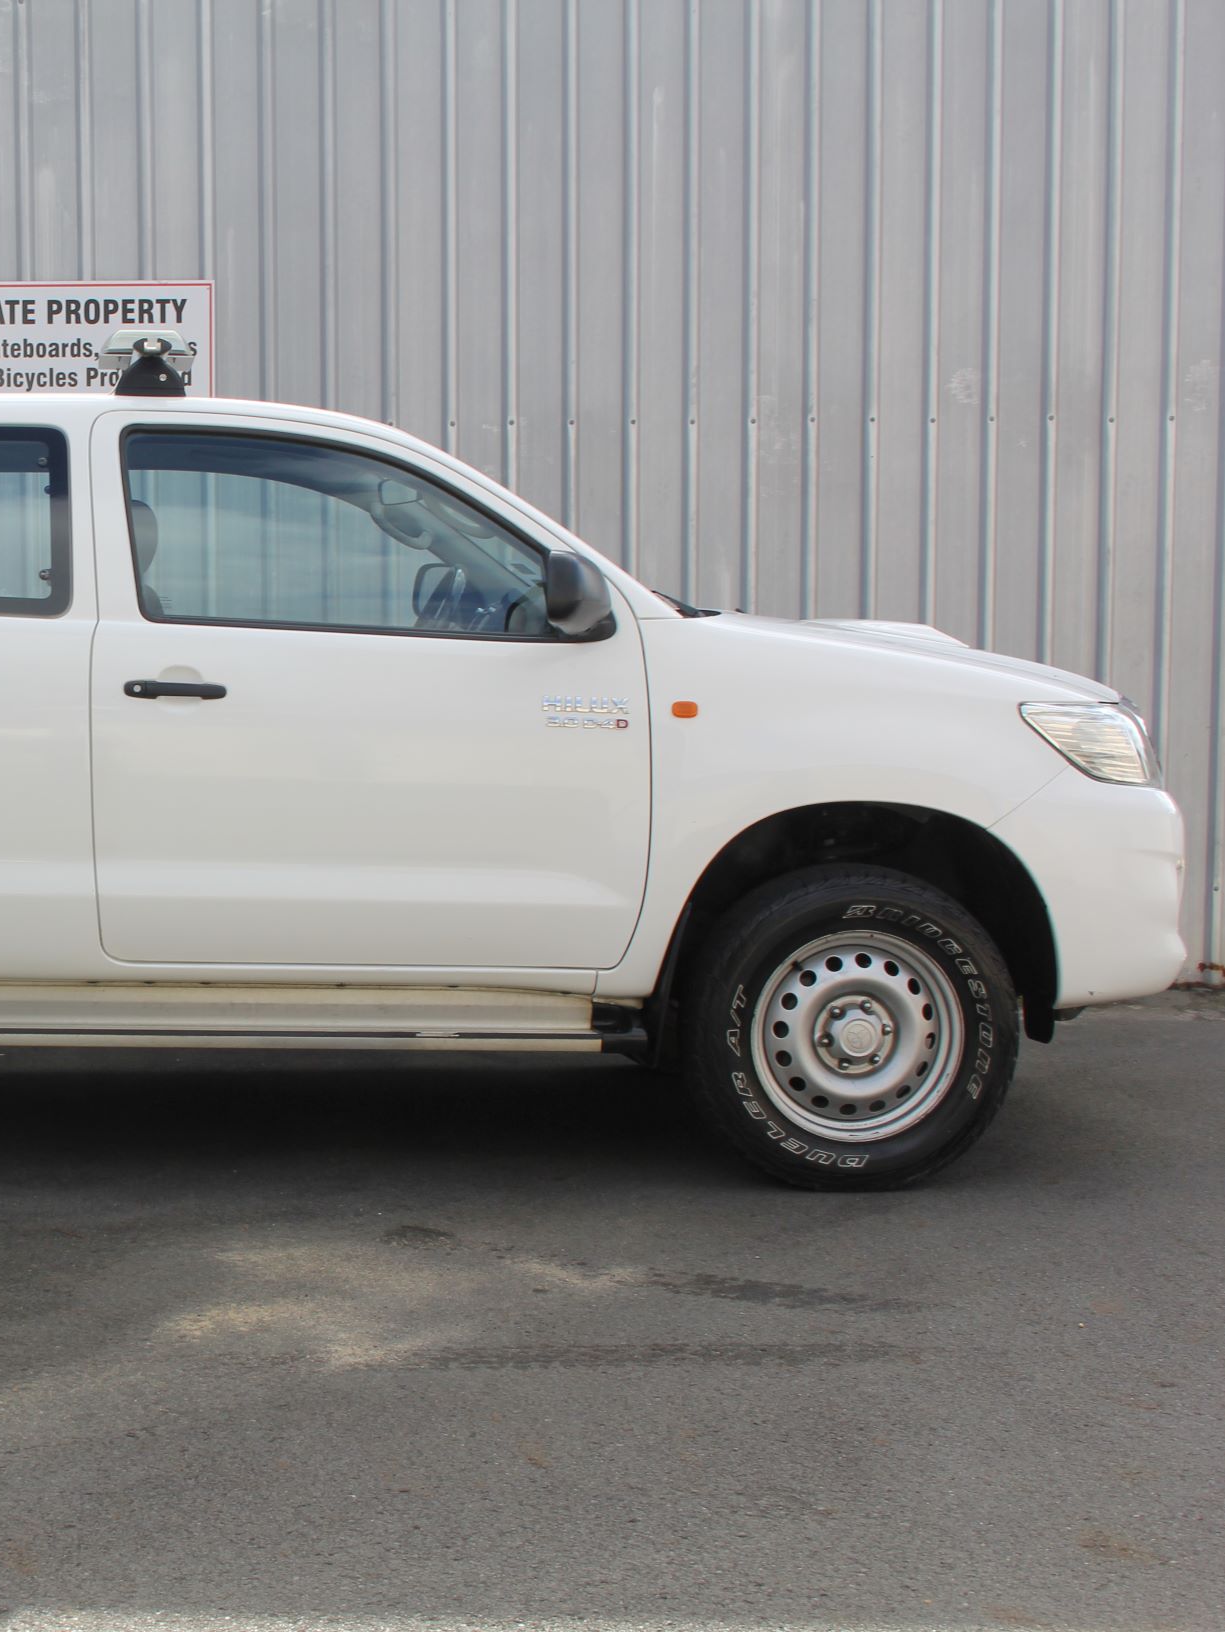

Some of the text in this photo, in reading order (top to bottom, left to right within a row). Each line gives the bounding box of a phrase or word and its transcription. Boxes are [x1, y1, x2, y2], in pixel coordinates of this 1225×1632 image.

[47, 299, 188, 324] PROPERTY
[542, 696, 630, 713] HILUX
[843, 904, 994, 1100] BRIDGESTONE
[727, 984, 869, 1168] DUELER A/T
